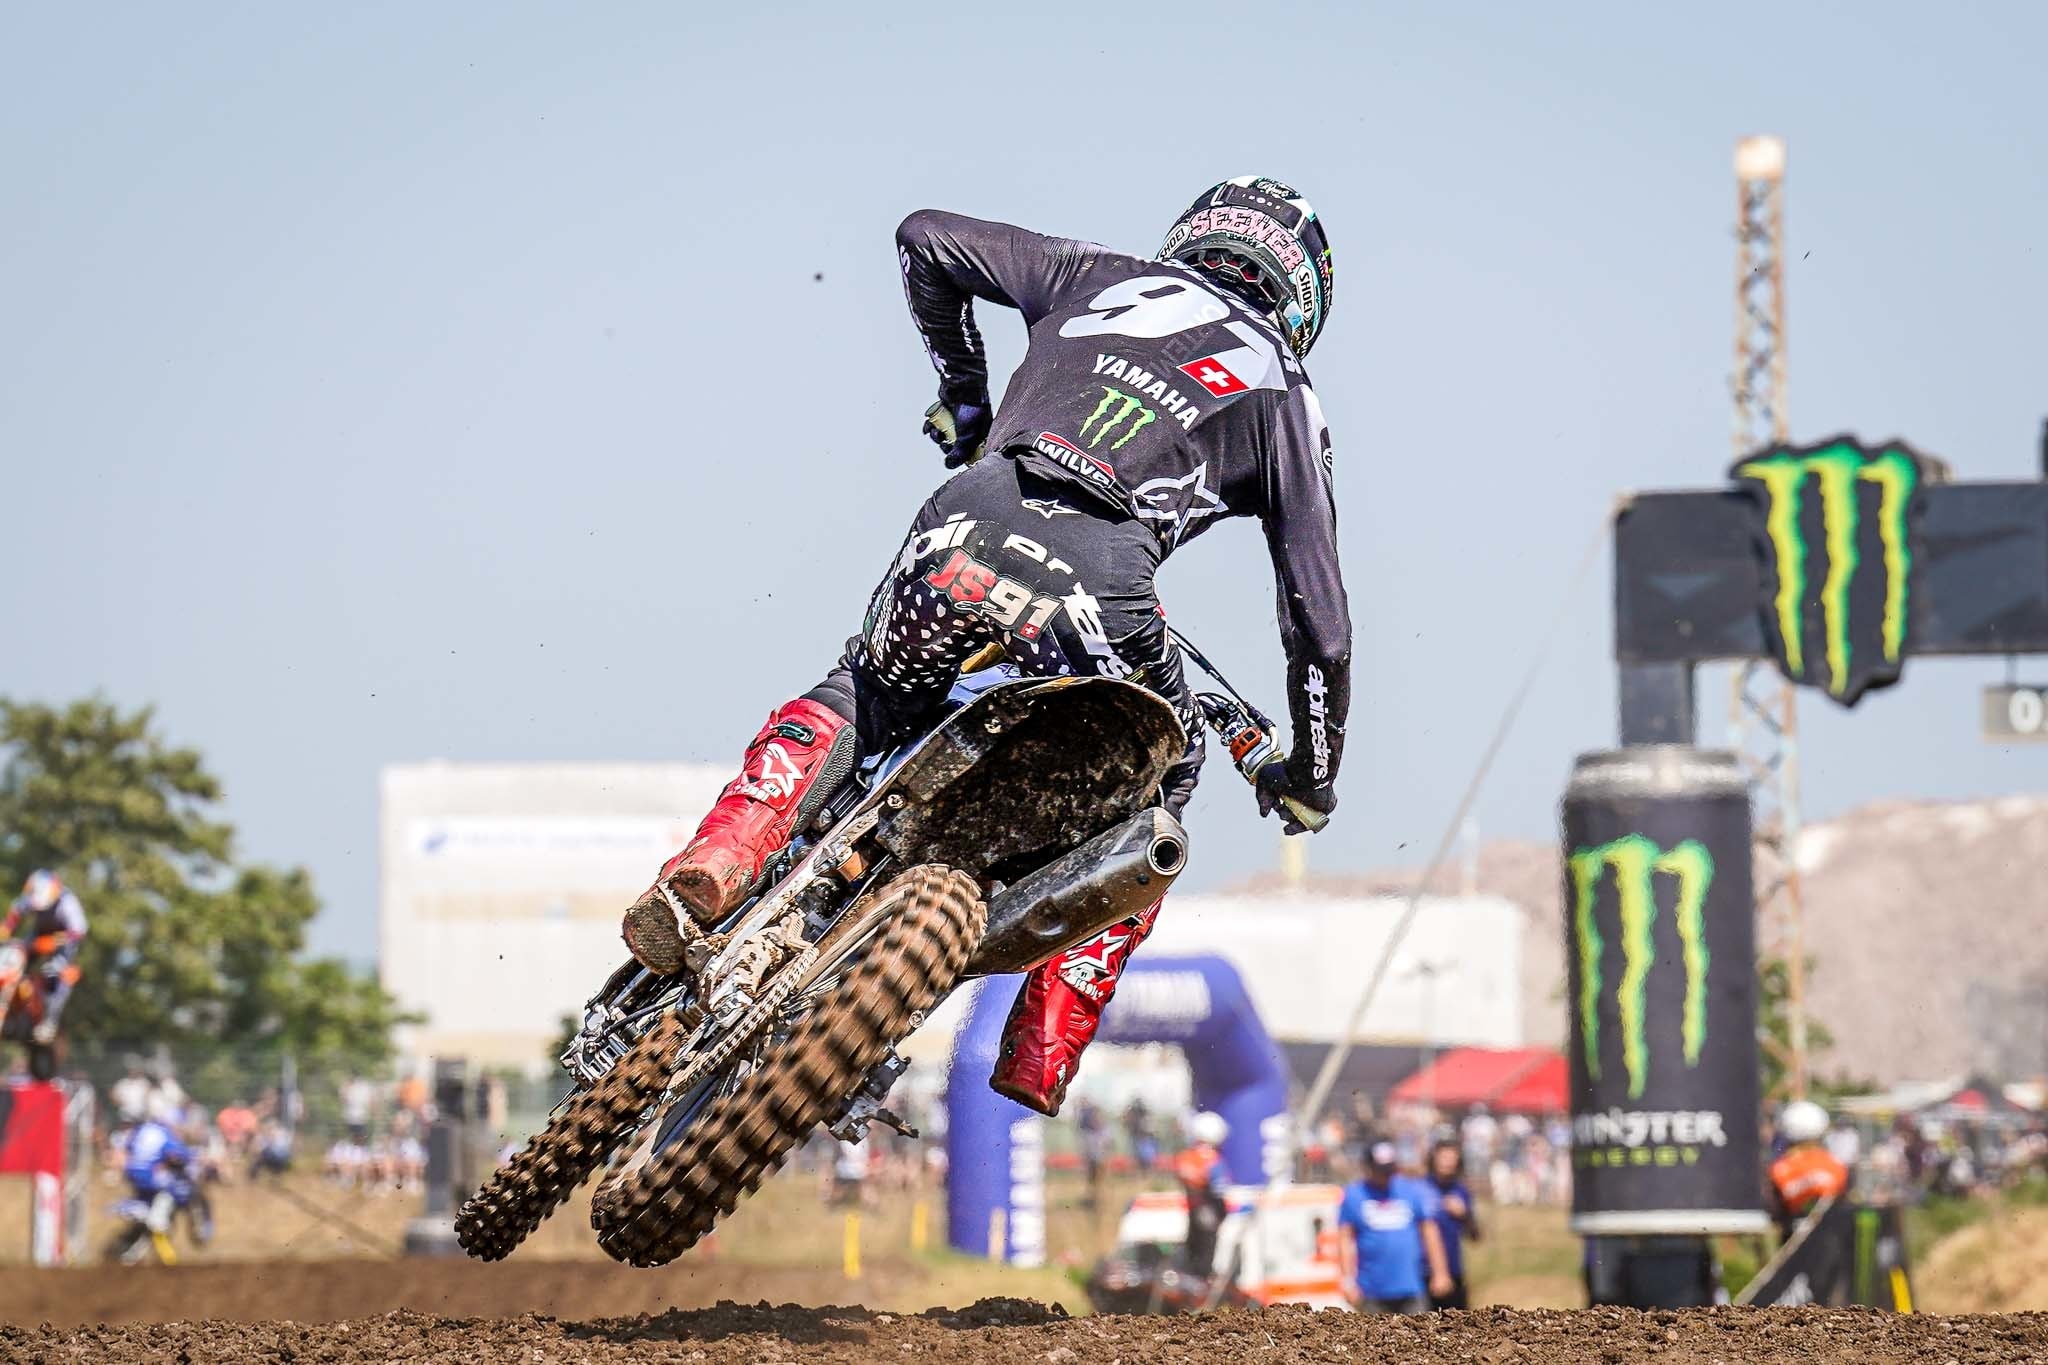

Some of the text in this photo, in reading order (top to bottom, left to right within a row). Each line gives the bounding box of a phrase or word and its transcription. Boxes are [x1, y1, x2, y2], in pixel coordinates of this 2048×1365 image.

[1190, 206, 1305, 274] SEEWER
[1299, 272, 1313, 313] SHOEI
[1091, 353, 1200, 431] YAMAHA
[926, 548, 1061, 639] JS91
[1304, 664, 1332, 780] alpinestars
[1574, 1106, 1728, 1148] ONSTER
